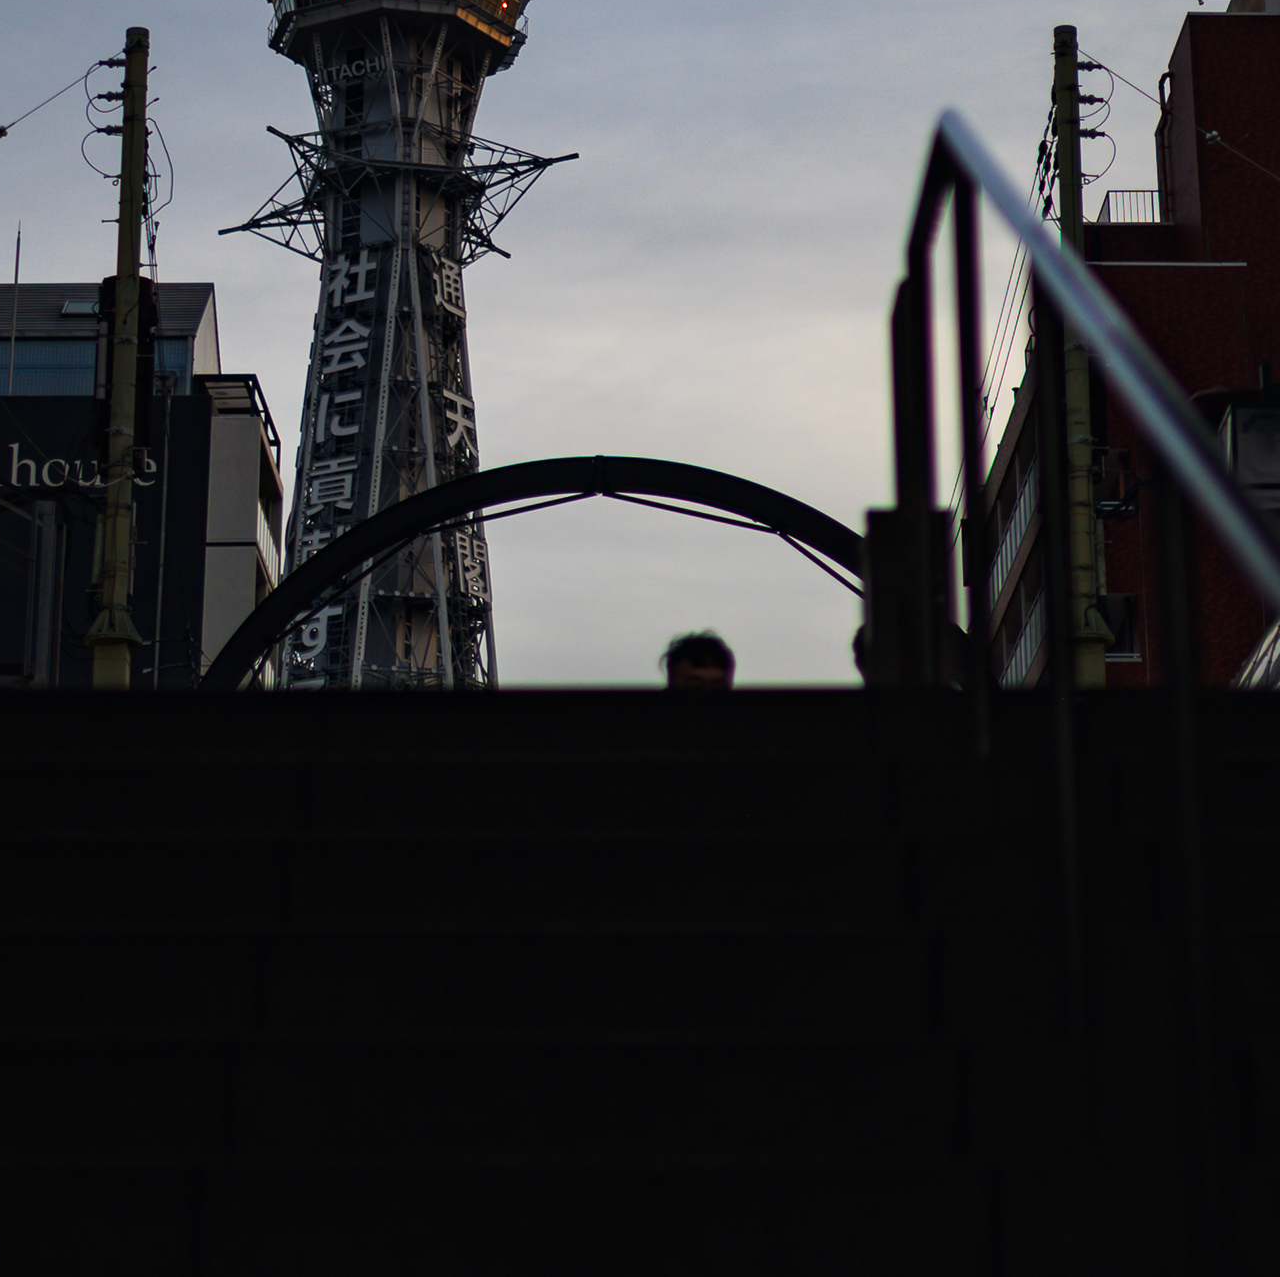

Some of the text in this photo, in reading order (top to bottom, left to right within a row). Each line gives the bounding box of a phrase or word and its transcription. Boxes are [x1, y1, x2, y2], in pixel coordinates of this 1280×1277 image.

[309, 56, 386, 89] HITACHI
[432, 255, 492, 604] 通天閣
